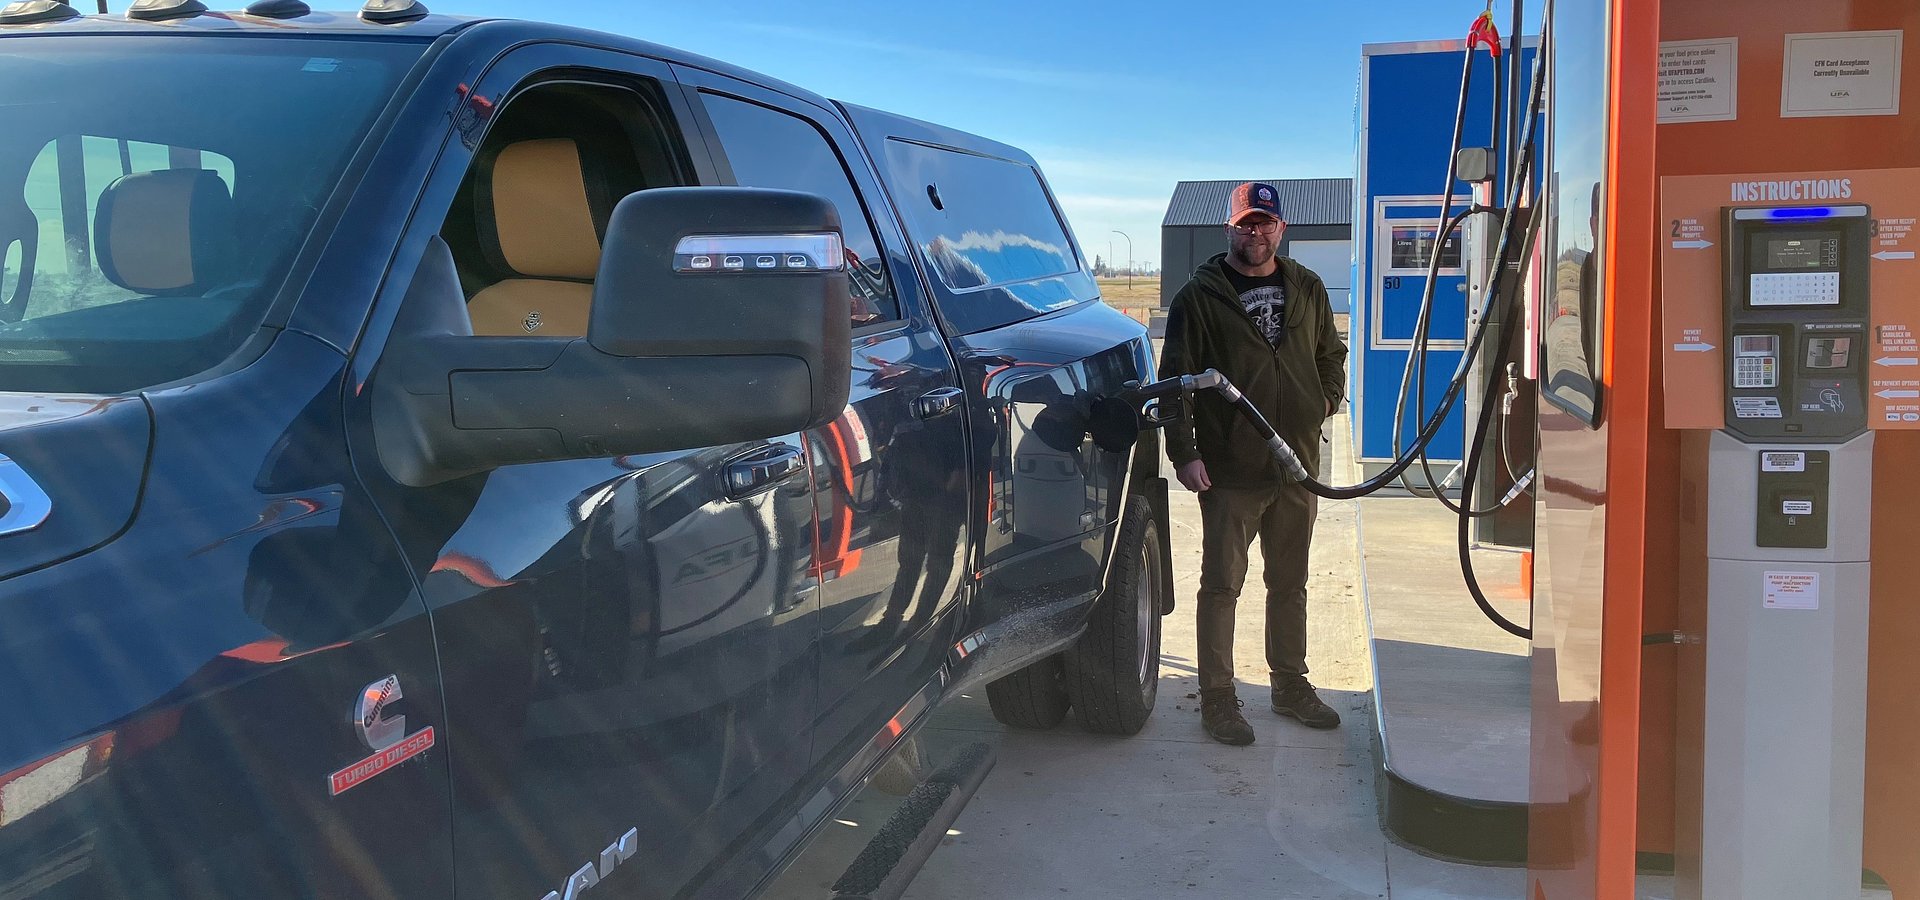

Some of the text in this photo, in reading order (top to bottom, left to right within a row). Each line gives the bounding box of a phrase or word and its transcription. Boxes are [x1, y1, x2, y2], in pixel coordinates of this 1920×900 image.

[1687, 49, 1699, 58] price
[1692, 58, 1706, 66] cards
[1839, 58, 1869, 68] Acceptance
[1668, 68, 1705, 76] UFAPETRO.COM
[1731, 179, 1852, 202] INSTRUCTIONS
[1671, 219, 1680, 238] 2
[1870, 219, 1879, 238] 3
[1384, 277, 1400, 289] 50
[1874, 325, 1881, 344] 1
[364, 676, 396, 728] Cummins
[334, 733, 433, 788] TURBO DIESEL
[541, 827, 638, 900] AM
